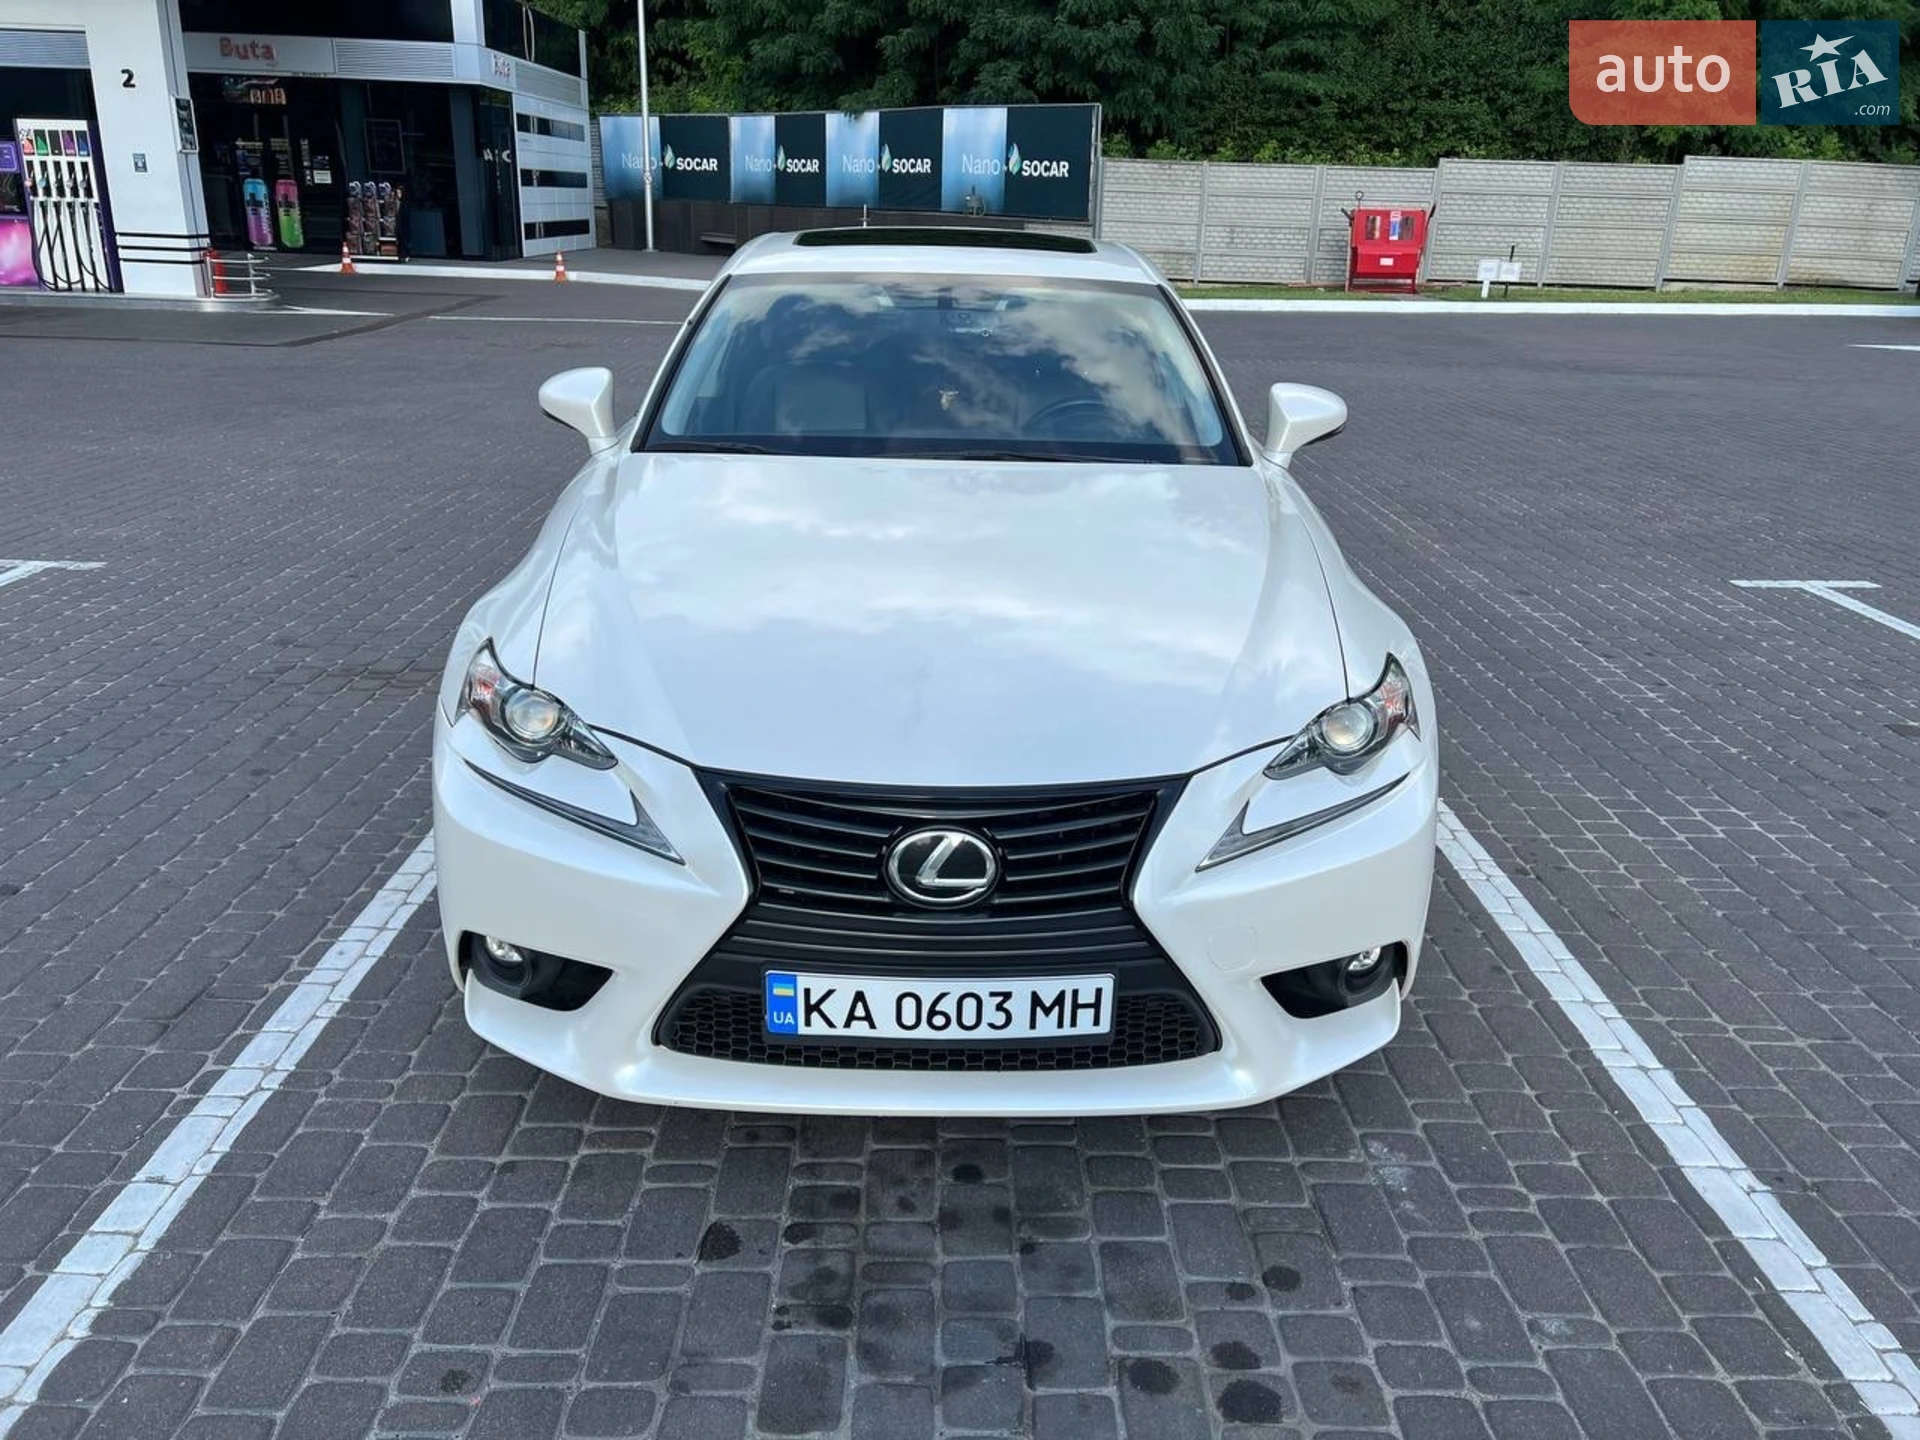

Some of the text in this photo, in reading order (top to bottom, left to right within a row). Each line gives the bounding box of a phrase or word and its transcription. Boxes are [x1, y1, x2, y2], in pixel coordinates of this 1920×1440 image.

[219, 37, 276, 60] Buta
[121, 69, 136, 88] 2
[677, 157, 718, 171] SOCAR
[745, 155, 820, 173] Nano SOCAR
[842, 154, 931, 173] Nano SOCAR
[961, 154, 1069, 177] Nano SOCAR
[802, 986, 1103, 1031] KA 0603 MH
[773, 1012, 796, 1025] UA
